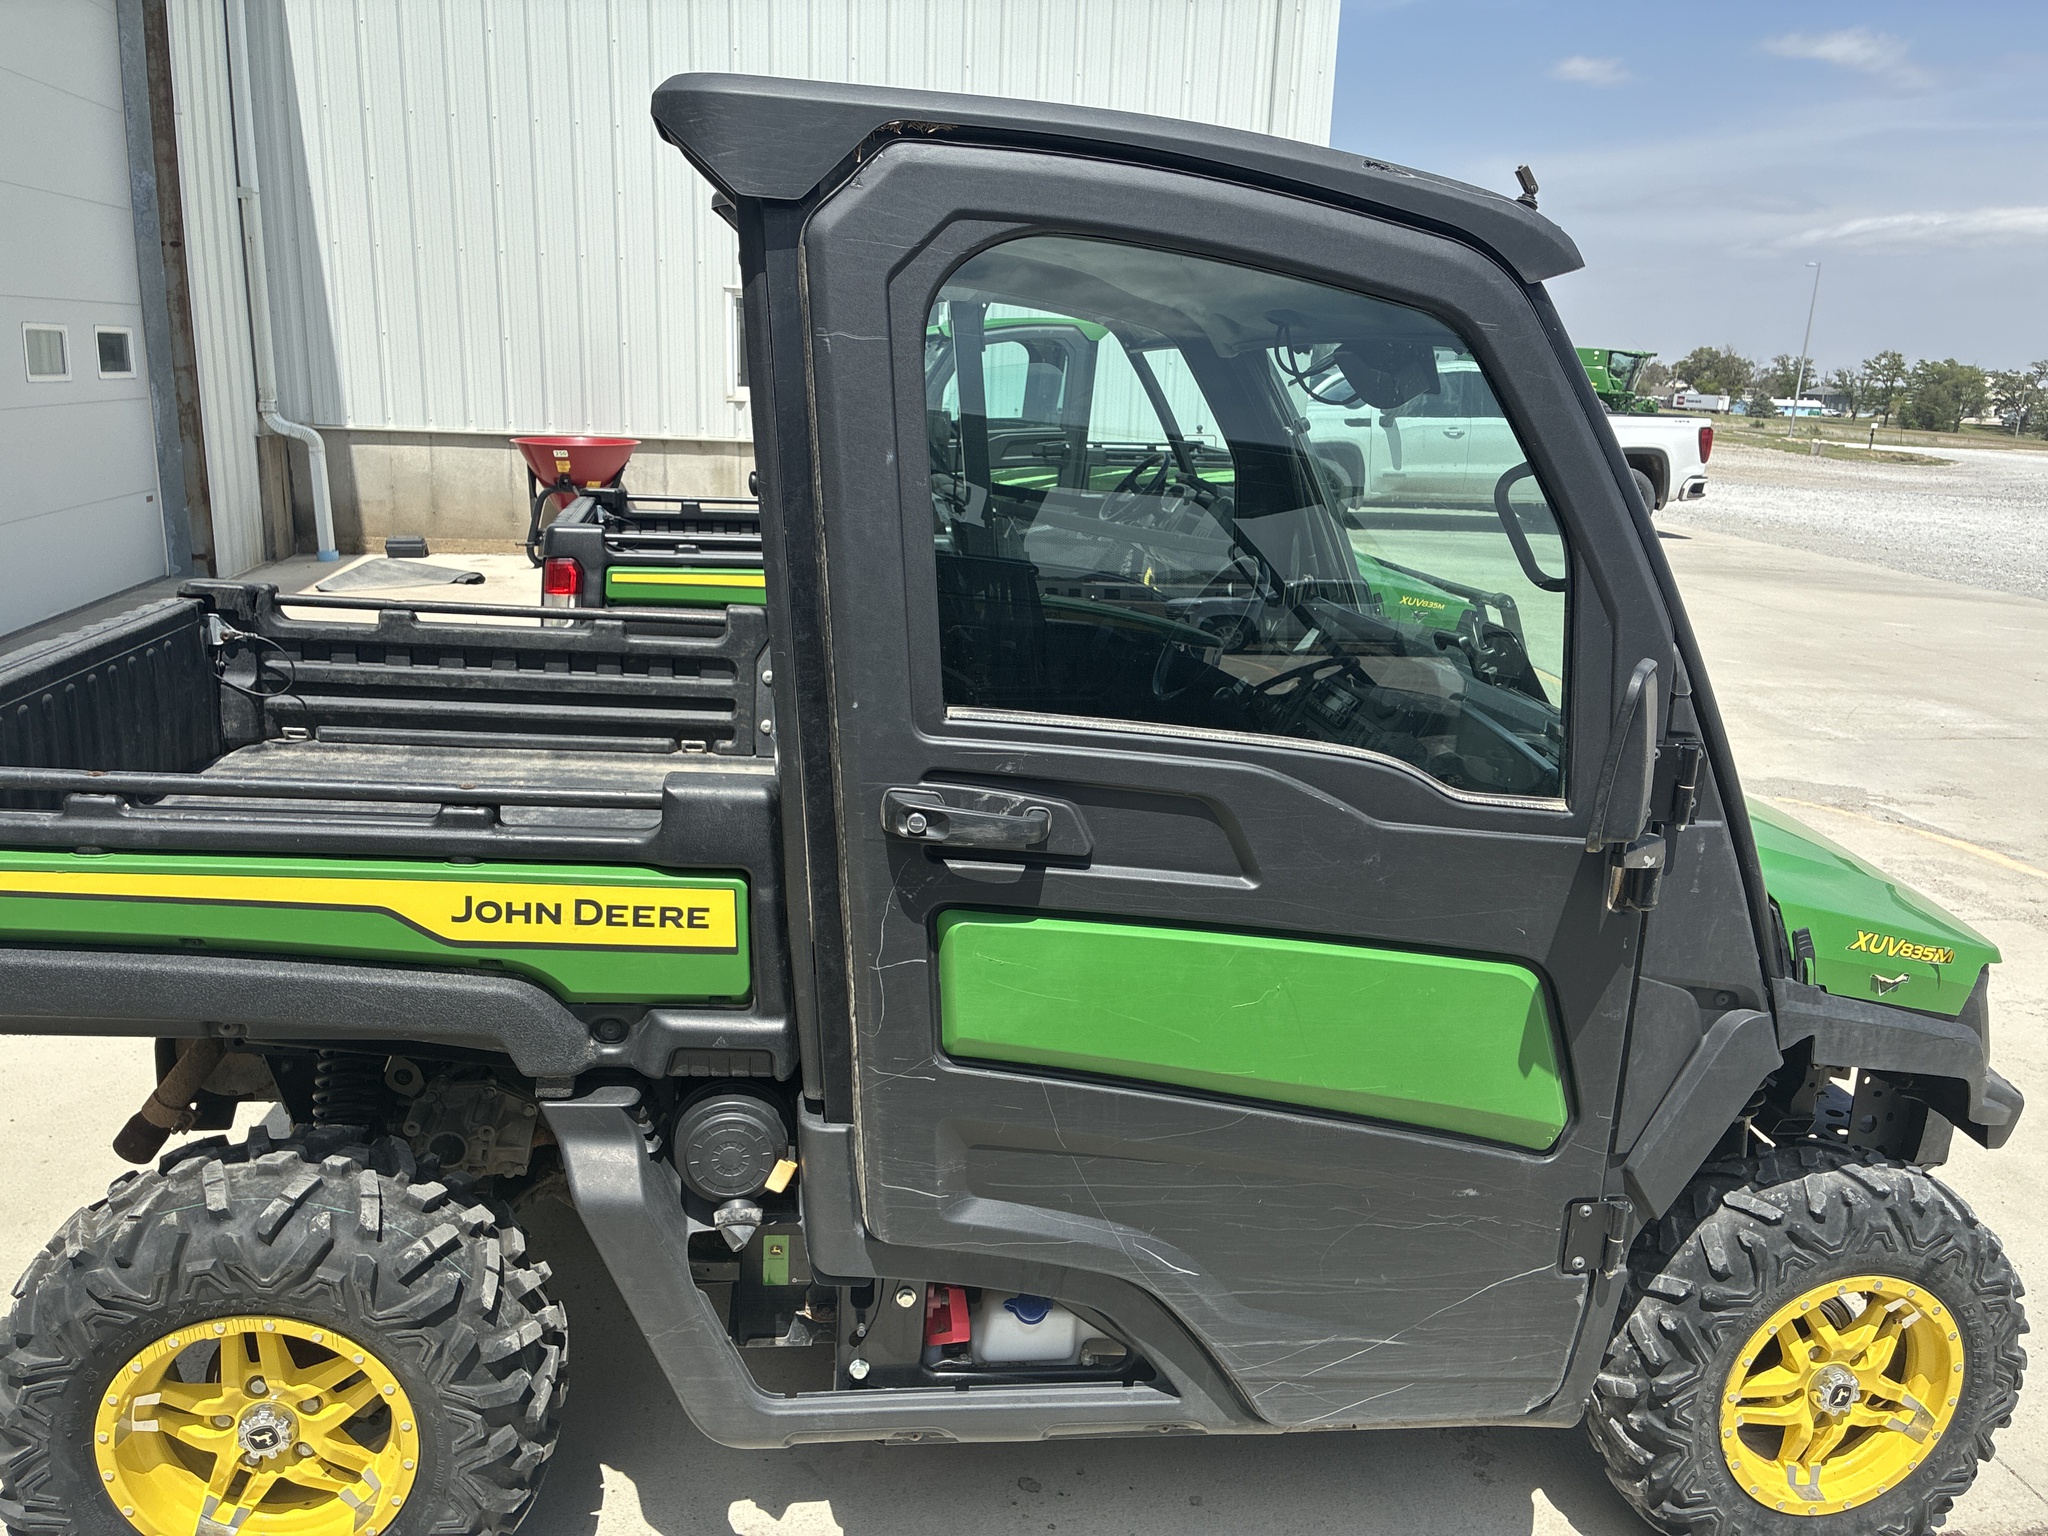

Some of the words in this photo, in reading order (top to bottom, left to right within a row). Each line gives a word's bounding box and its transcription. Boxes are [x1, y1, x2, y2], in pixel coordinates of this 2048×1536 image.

[1399, 595, 1445, 610] XUV835M
[451, 895, 562, 925] JOHN
[574, 898, 710, 930] DEERE
[1848, 930, 1956, 964] XUV835M
